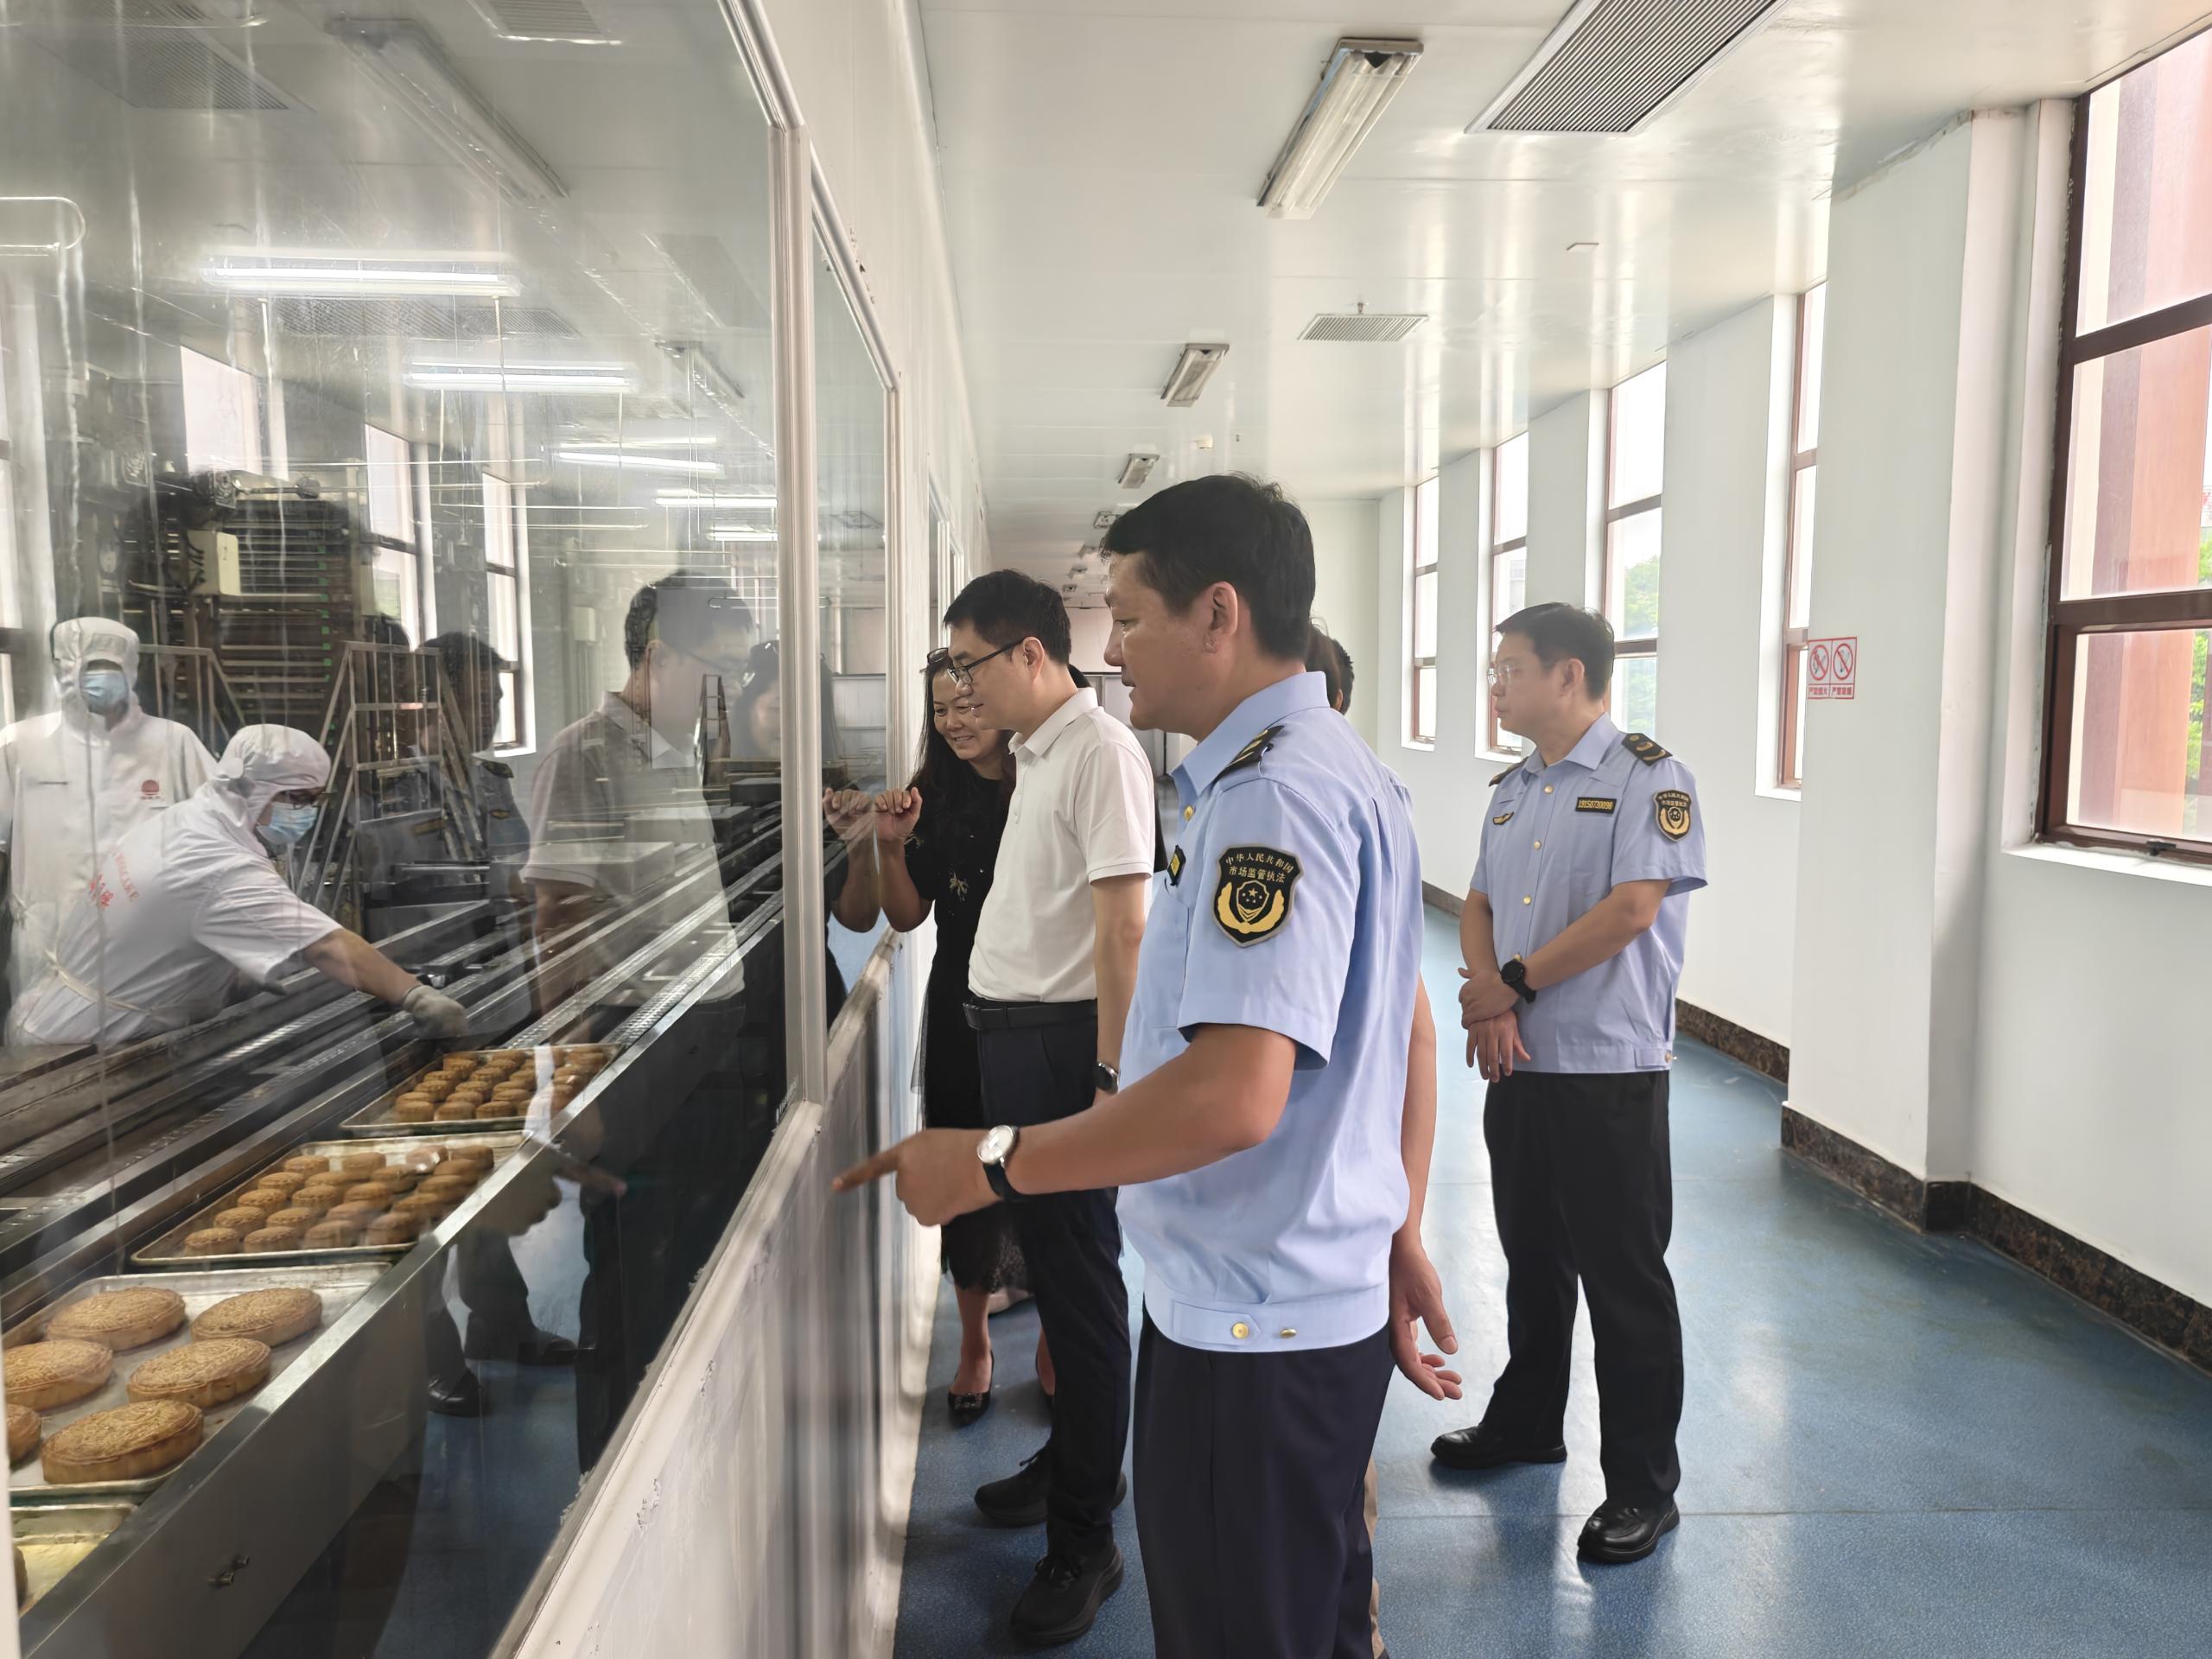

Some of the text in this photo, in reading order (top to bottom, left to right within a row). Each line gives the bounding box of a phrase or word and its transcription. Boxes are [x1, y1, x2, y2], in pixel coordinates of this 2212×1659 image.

[1225, 852, 1294, 874] 中华人民共和国
[1229, 866, 1286, 883] 市场监管执法
